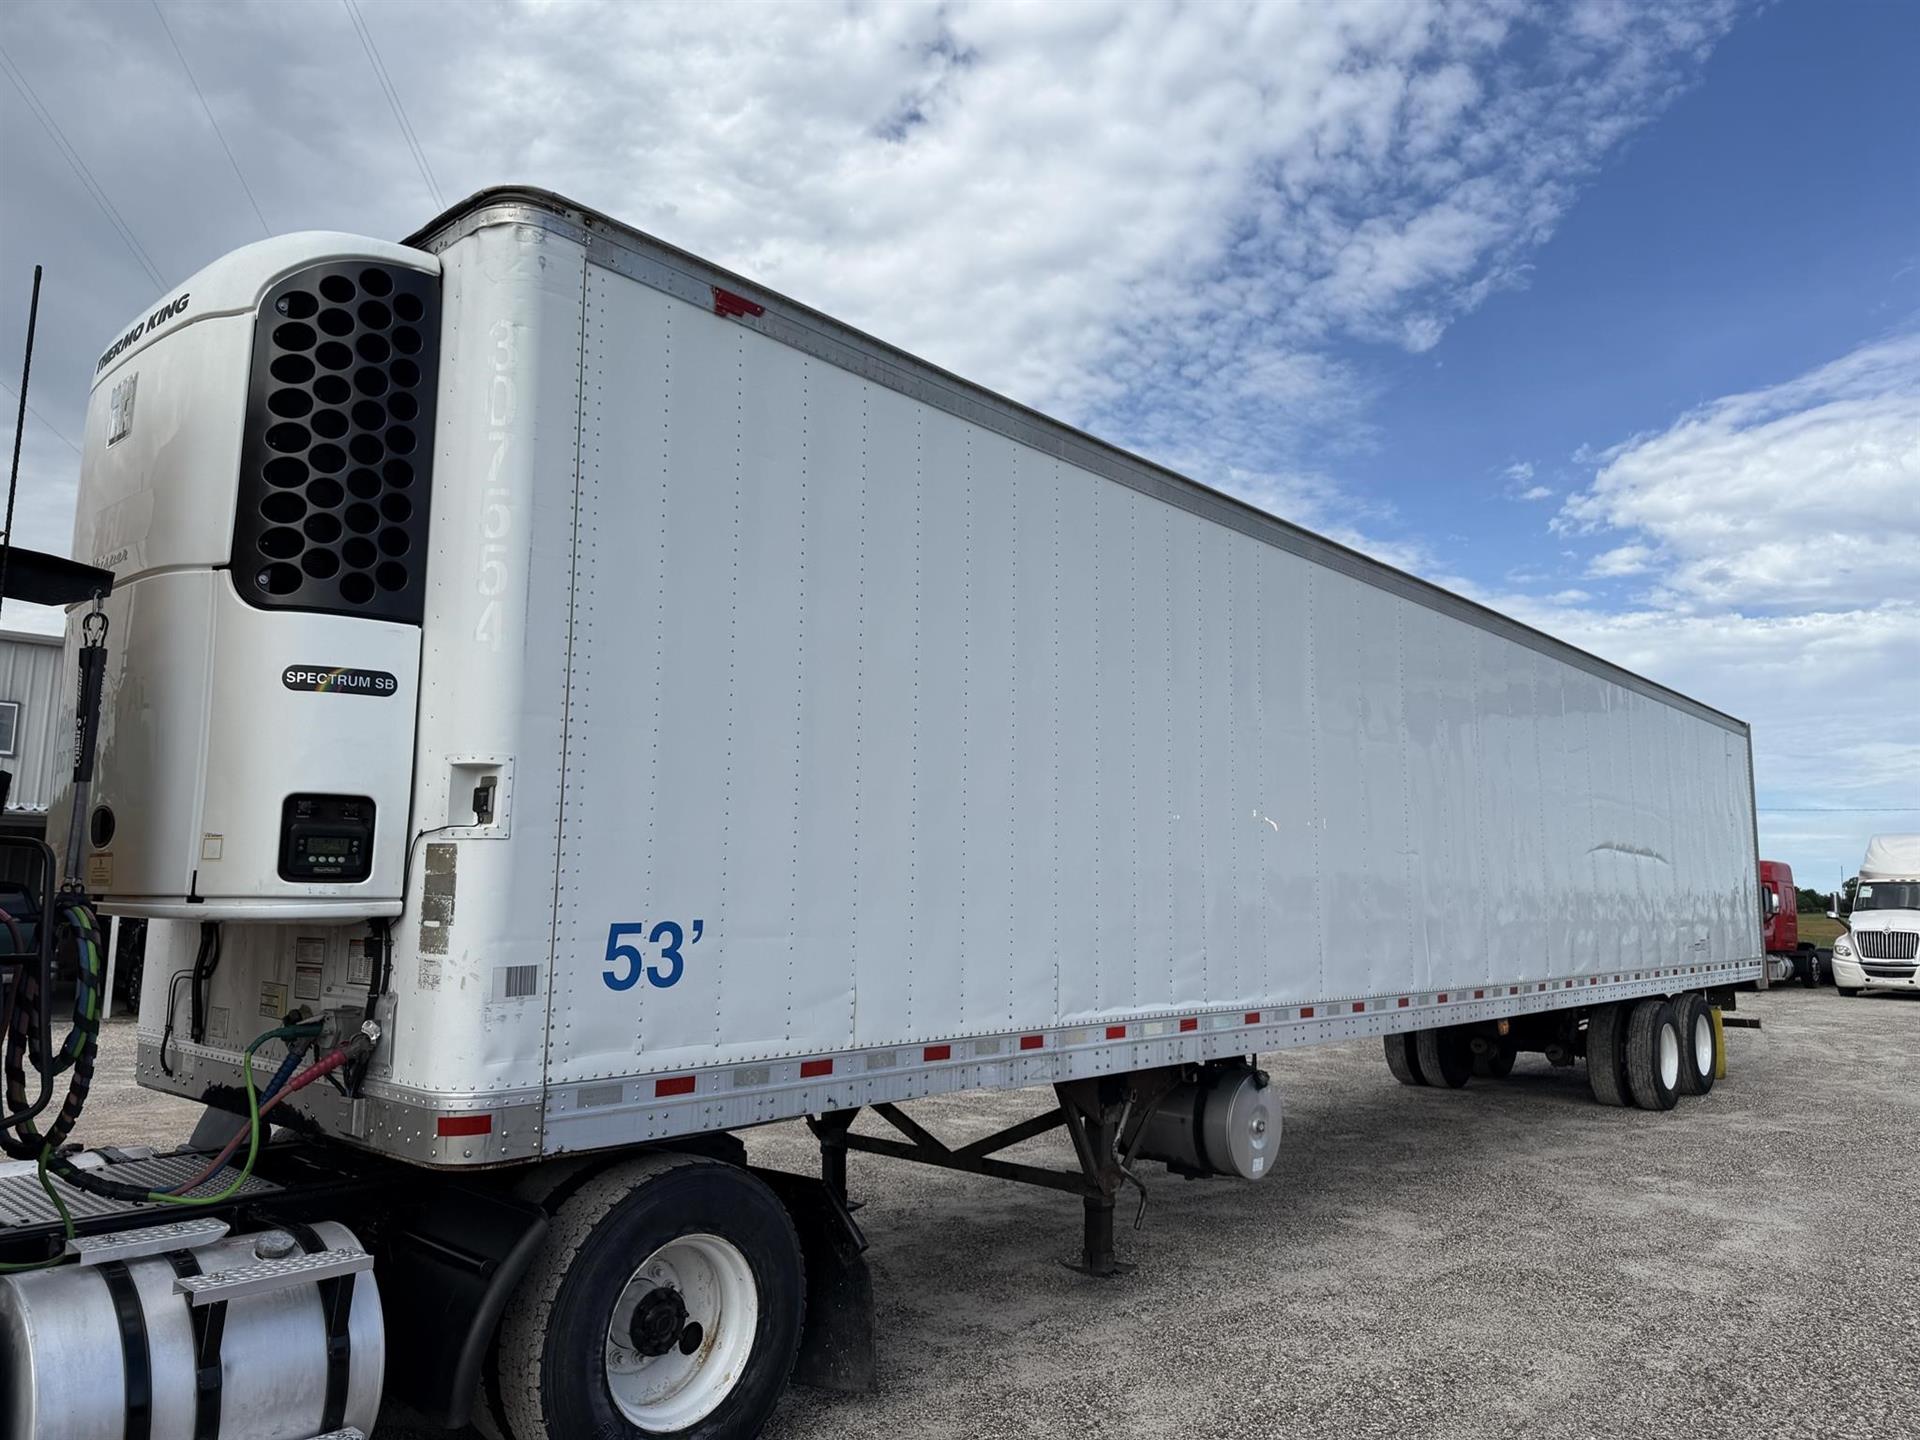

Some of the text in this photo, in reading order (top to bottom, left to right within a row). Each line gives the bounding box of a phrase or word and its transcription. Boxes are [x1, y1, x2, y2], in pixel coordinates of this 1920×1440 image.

[96, 293, 190, 375] THERMO KING
[286, 671, 395, 690] SPECTRUM SB
